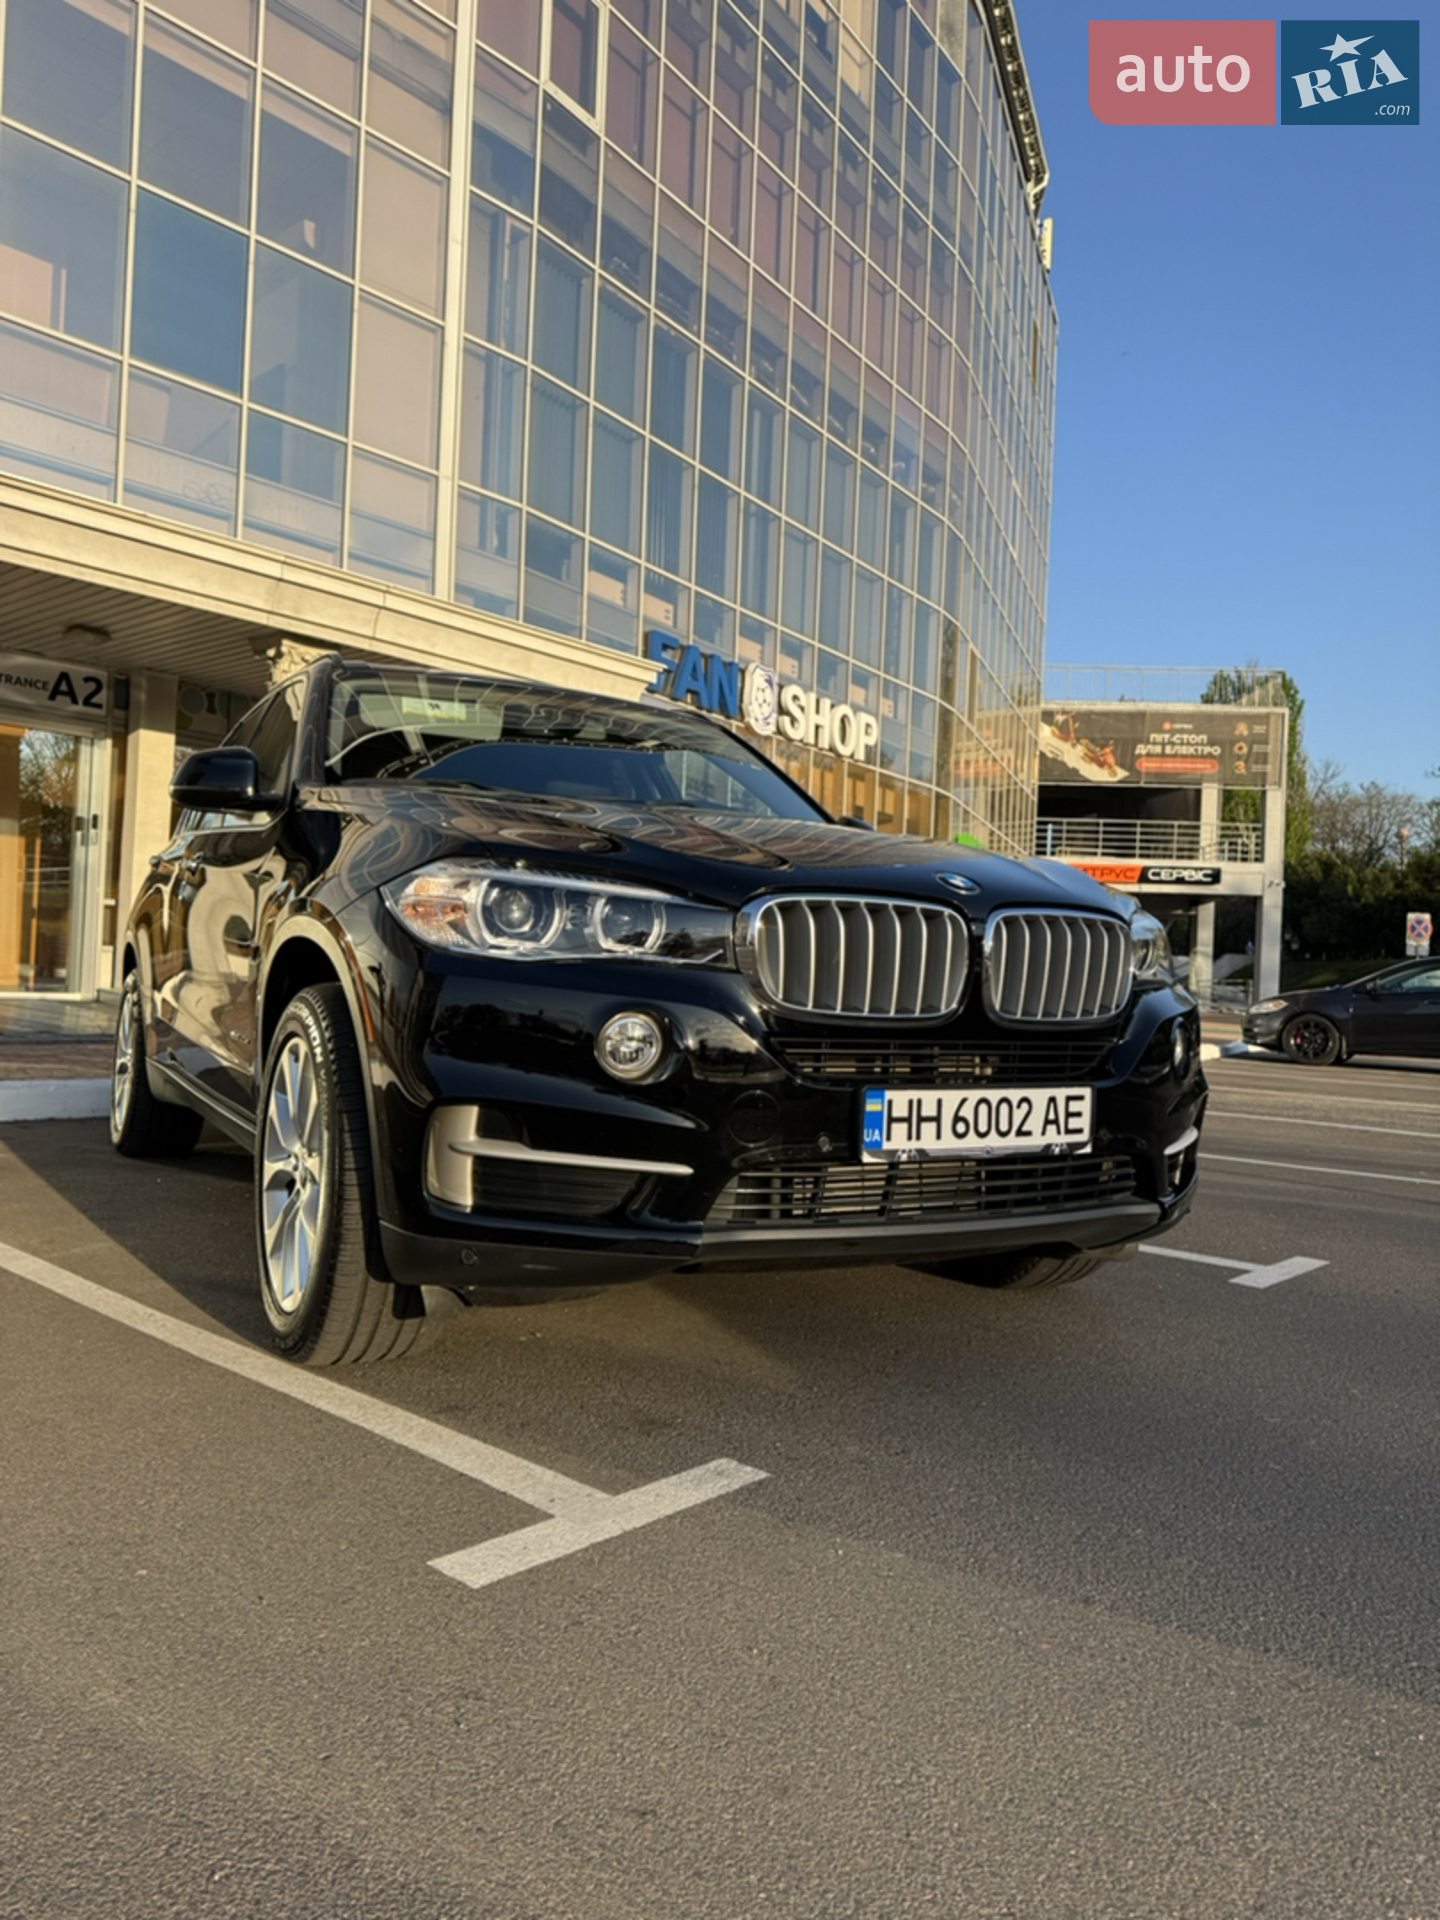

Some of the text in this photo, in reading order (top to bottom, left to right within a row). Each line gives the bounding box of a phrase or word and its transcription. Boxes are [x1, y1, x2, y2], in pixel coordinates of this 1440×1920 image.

[47, 671, 104, 710] A2
[649, 629, 879, 761] FAN SHOP
[1134, 743, 1222, 756] ДЛЯ ЕЛЕКТРО
[1083, 867, 1136, 880] ТРУС
[885, 1095, 1085, 1142] HH 6002 AE
[863, 1128, 881, 1142] UA
